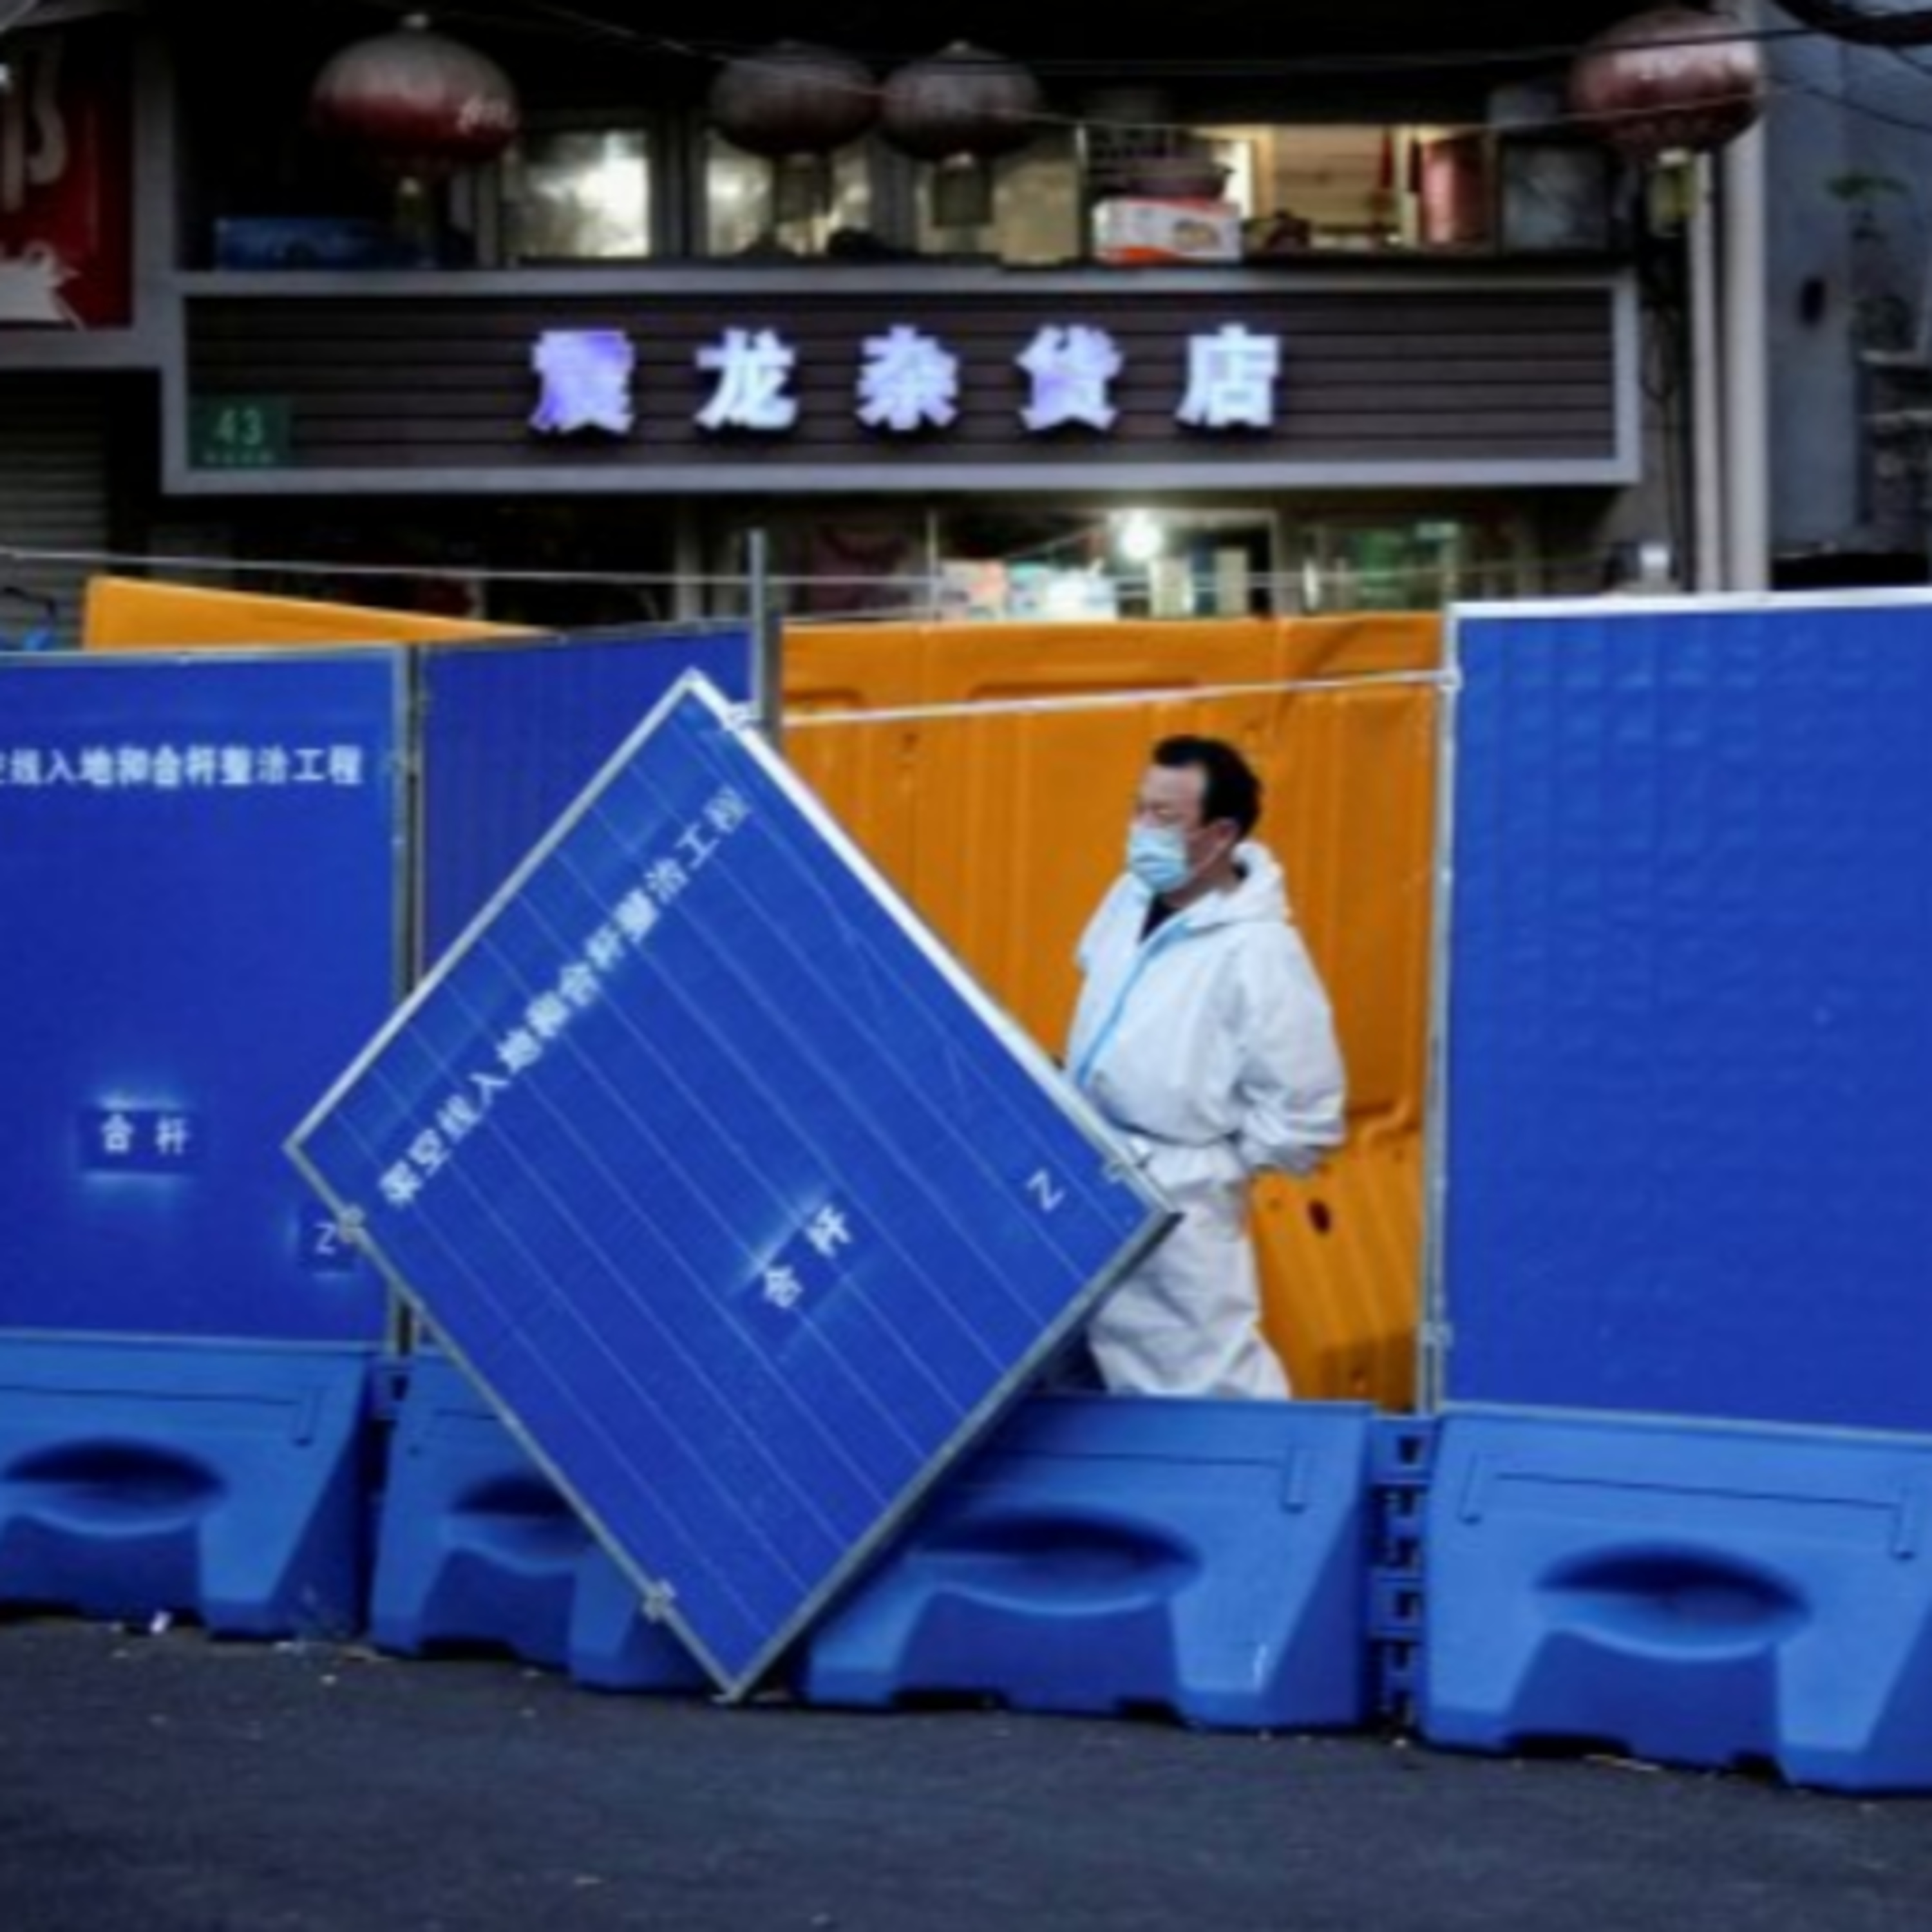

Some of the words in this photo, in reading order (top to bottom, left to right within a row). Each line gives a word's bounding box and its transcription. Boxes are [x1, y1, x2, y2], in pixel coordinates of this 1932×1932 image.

[214, 407, 265, 446] 43
[0, 744, 362, 787] 线入地和合杆整治工程
